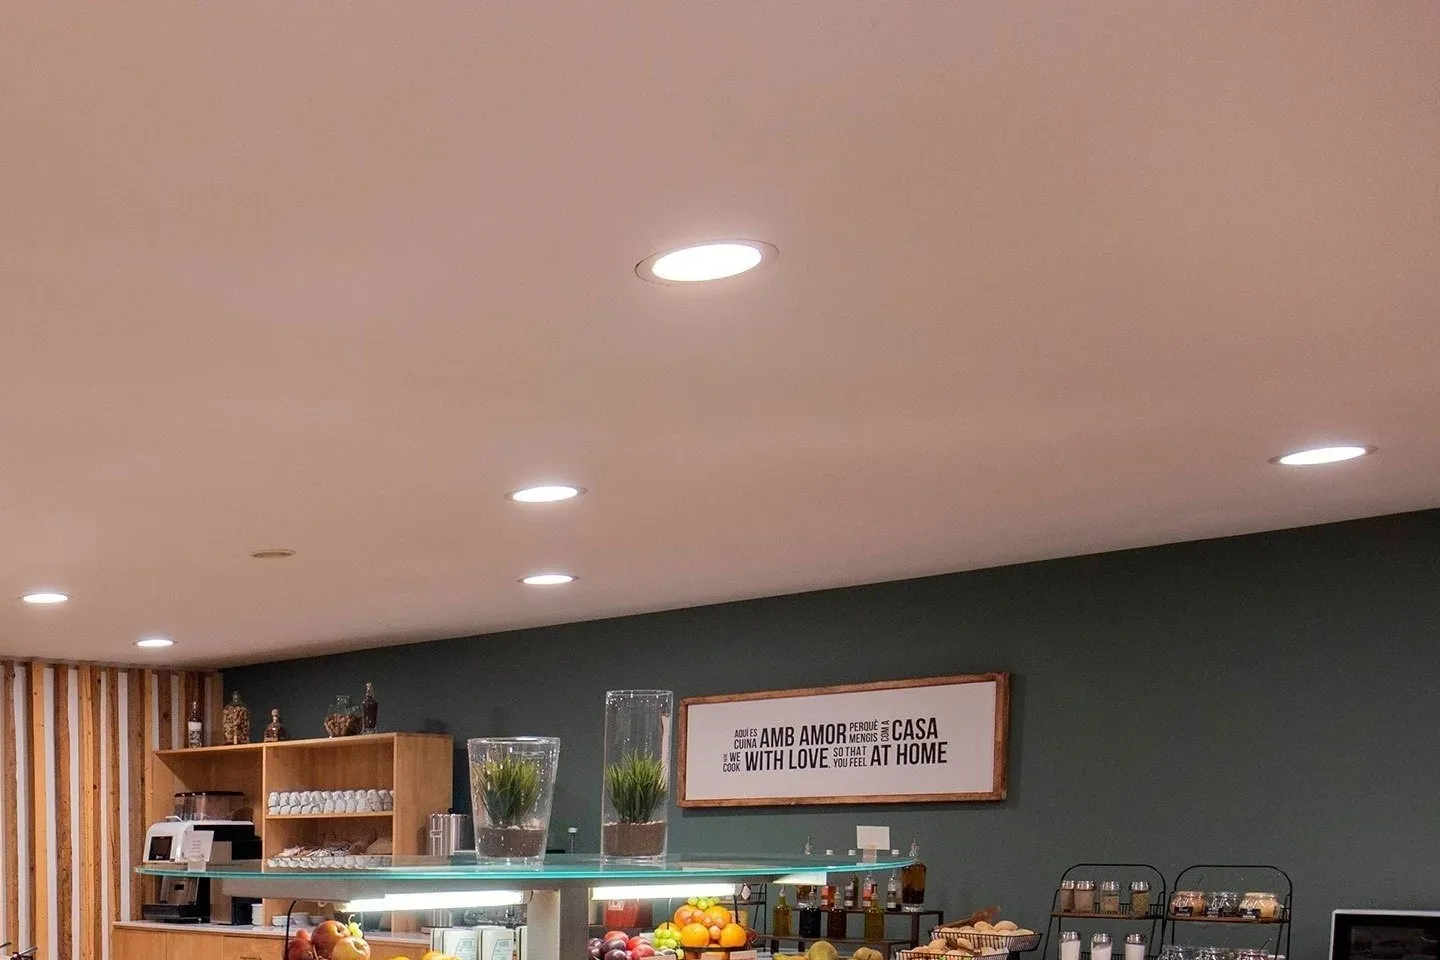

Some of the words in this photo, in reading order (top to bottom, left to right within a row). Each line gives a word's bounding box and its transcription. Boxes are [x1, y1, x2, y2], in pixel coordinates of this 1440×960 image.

[849, 719, 879, 732] PERQUÈ
[892, 717, 938, 741] CASA
[750, 728, 758, 737] ES
[759, 726, 795, 748] AMB
[799, 723, 847, 746] AMOR
[849, 732, 878, 743] MENGIS
[880, 727, 890, 741] COM
[734, 738, 757, 749] CUINA
[729, 752, 741, 762] WE
[833, 747, 843, 757] SO
[845, 745, 867, 756] THAT
[870, 744, 891, 766] AT
[896, 741, 948, 765] HOME
[745, 750, 784, 771] WITH
[833, 758, 848, 768] YOU
[849, 757, 867, 767] FEEL
[723, 762, 741, 772] COOK
